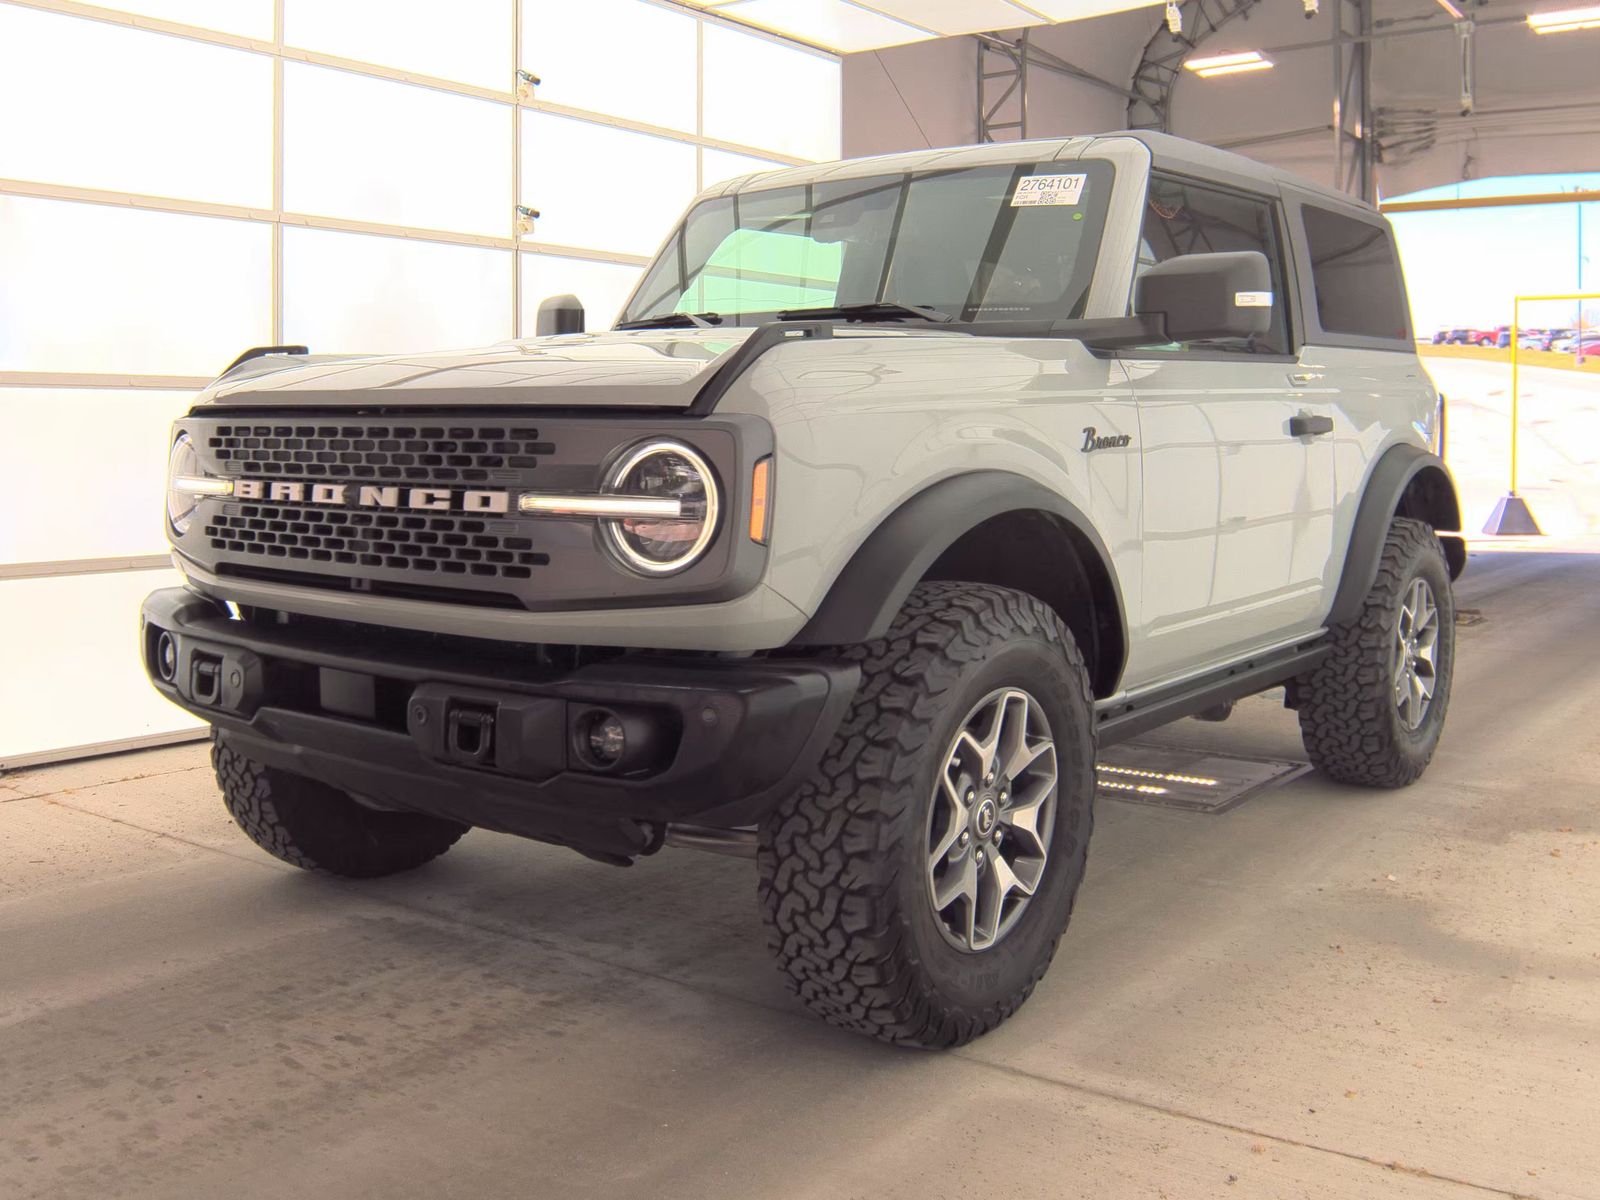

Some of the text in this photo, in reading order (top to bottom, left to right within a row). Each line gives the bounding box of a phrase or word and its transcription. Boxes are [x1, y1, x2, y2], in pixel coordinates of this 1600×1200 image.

[1020, 177, 1080, 191] 2764101
[1080, 426, 1132, 453] Bronco
[233, 479, 509, 513] BRONCO
